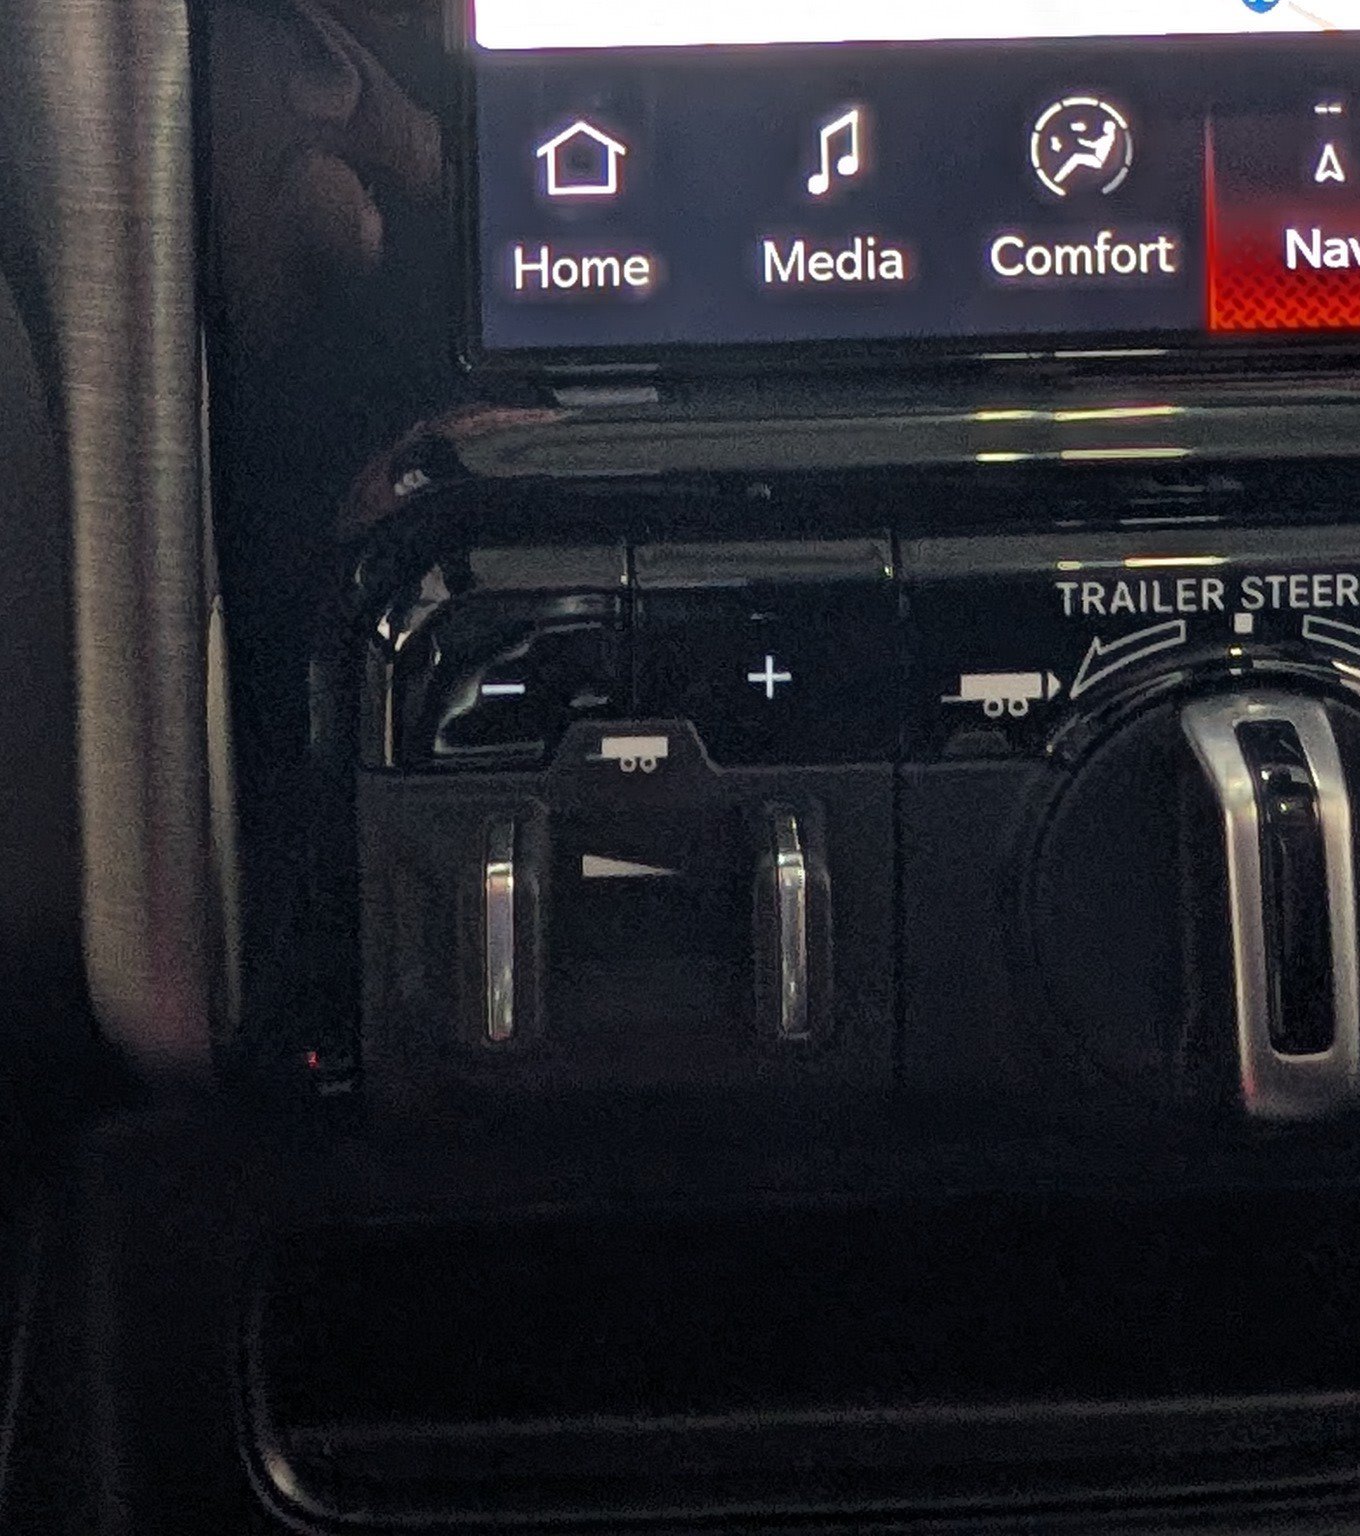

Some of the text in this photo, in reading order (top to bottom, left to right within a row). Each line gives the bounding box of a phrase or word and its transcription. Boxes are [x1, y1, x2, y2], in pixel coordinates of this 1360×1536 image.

[513, 245, 651, 289] Home
[762, 237, 904, 283] Media
[990, 230, 1176, 277] Comfort
[1055, 577, 1226, 616] TRAILER
